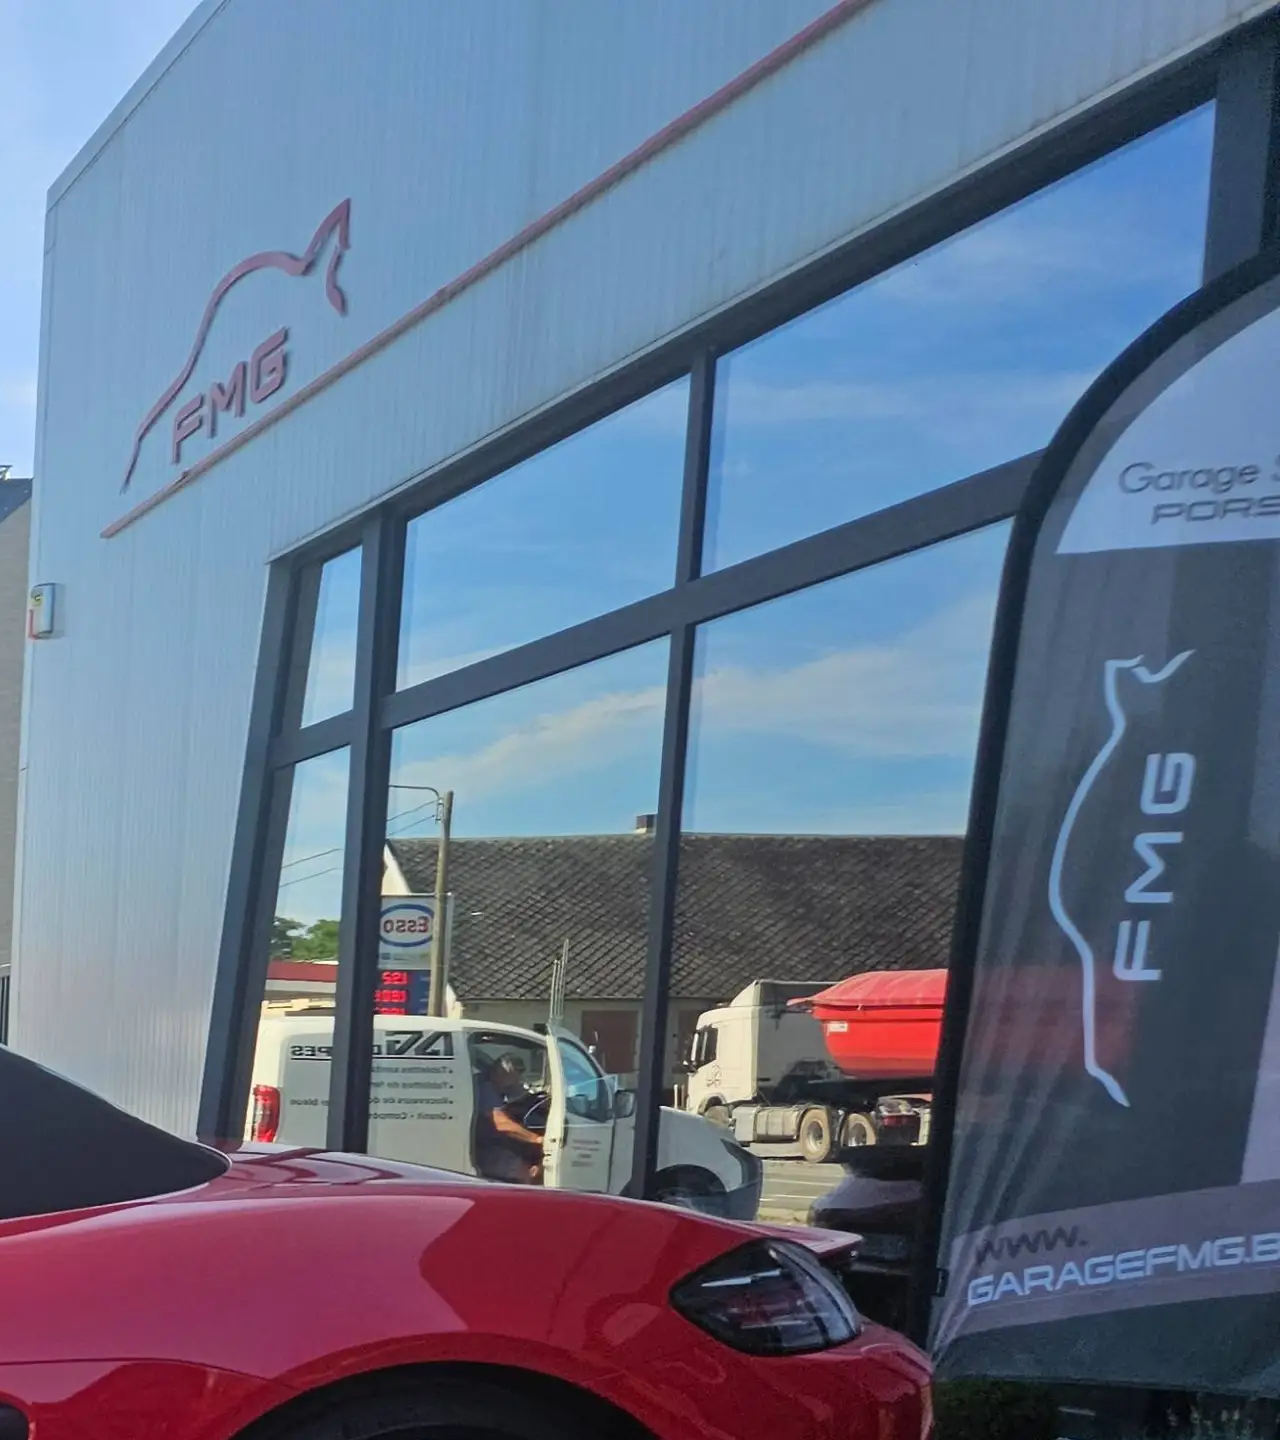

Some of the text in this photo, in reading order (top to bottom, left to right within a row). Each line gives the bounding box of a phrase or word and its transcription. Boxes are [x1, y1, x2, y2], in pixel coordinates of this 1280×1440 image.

[171, 326, 291, 464] FMG
[1118, 461, 1261, 494] Garage
[1112, 752, 1196, 981] FMG
[967, 1231, 1280, 1306] GARAGEFMG.B
